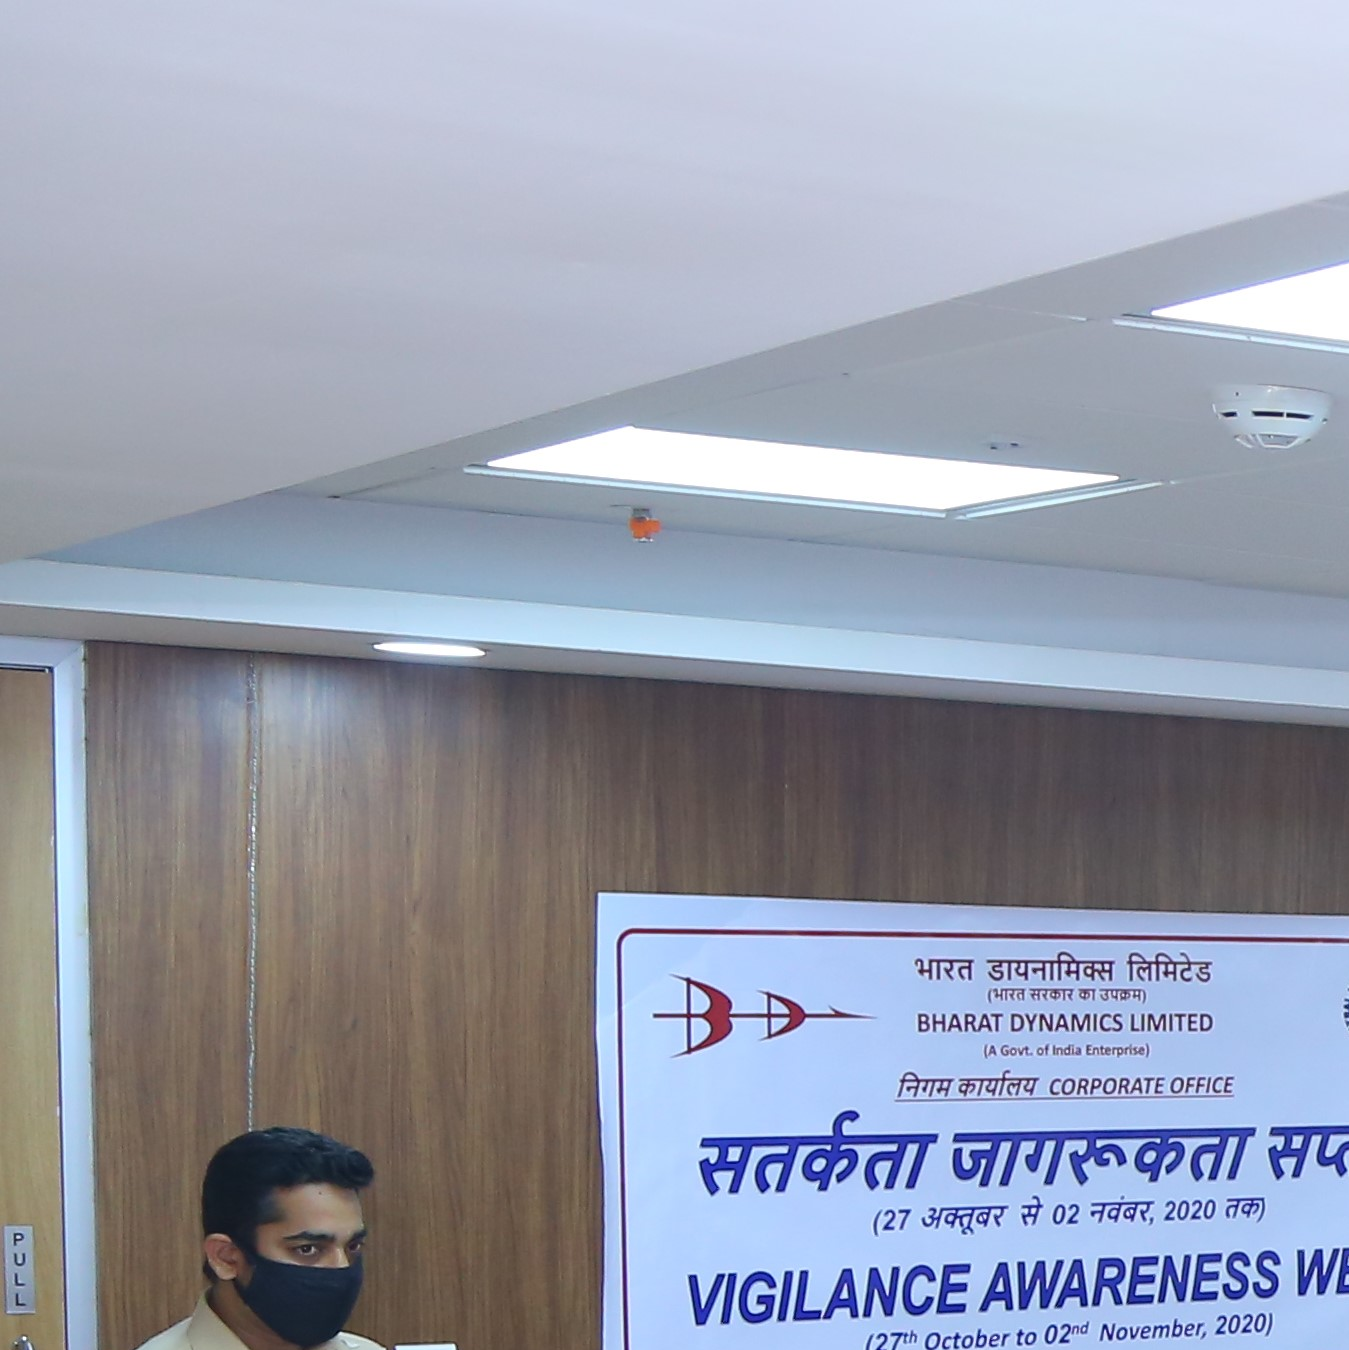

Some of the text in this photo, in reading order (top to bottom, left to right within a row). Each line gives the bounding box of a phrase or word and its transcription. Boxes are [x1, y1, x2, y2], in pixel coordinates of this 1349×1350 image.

[915, 952, 1213, 983] भारत डायनामिक्स लिमिटेड
[987, 988, 1147, 1004] (भारत सरकार का उपक्रम)
[917, 1013, 1214, 1033] BHARAT DYNAMICS LIMITED
[984, 1044, 1150, 1058] (A Govt. of India Enterprise)
[897, 1070, 1235, 1098] निगम कार्यालय CORPORATE OFFICE
[699, 1110, 939, 1196] सतर्कता
[951, 1126, 1256, 1187] जागरूकता
[872, 1195, 1266, 1236] (27 अक्तूबर से 02 नवंबर, 2020 तक)
[13, 1232, 27, 1307] PULL
[687, 1263, 972, 1327] VIGILANCE
[979, 1250, 1282, 1313] AWARENESS
[1015, 1327, 1037, 1347] to
[1044, 1320, 1089, 1346] 02nd
[1100, 1317, 1208, 1342] November,
[1215, 1312, 1274, 1337] 2020)
